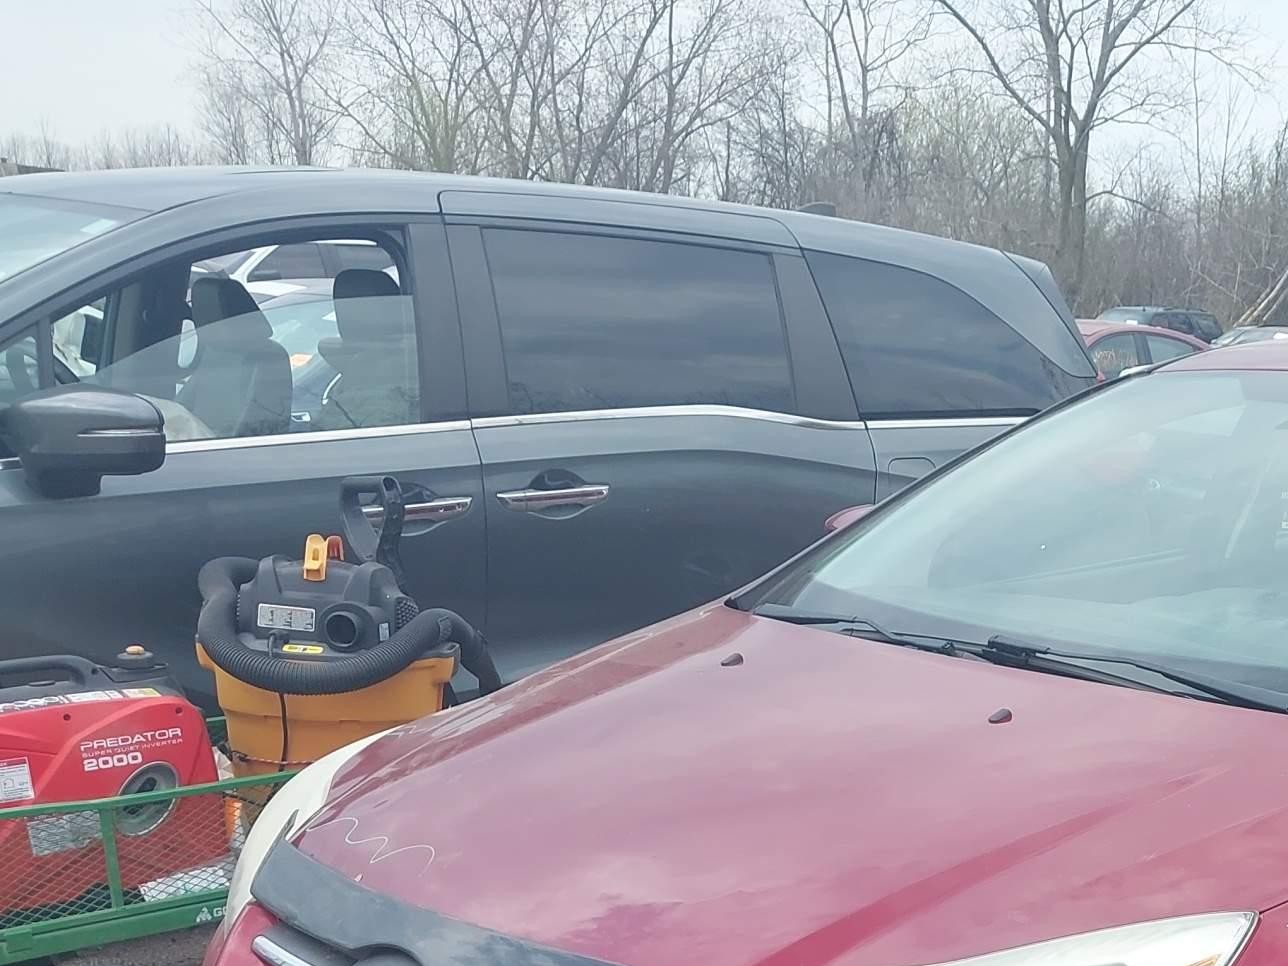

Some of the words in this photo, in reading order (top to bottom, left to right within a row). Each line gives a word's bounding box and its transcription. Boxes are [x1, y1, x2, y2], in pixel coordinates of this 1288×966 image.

[80, 727, 182, 752] PREDATOR
[81, 747, 113, 759] SUPER
[114, 744, 140, 754] QUIET
[142, 738, 183, 750] INVERTER
[83, 751, 143, 772] 2000
